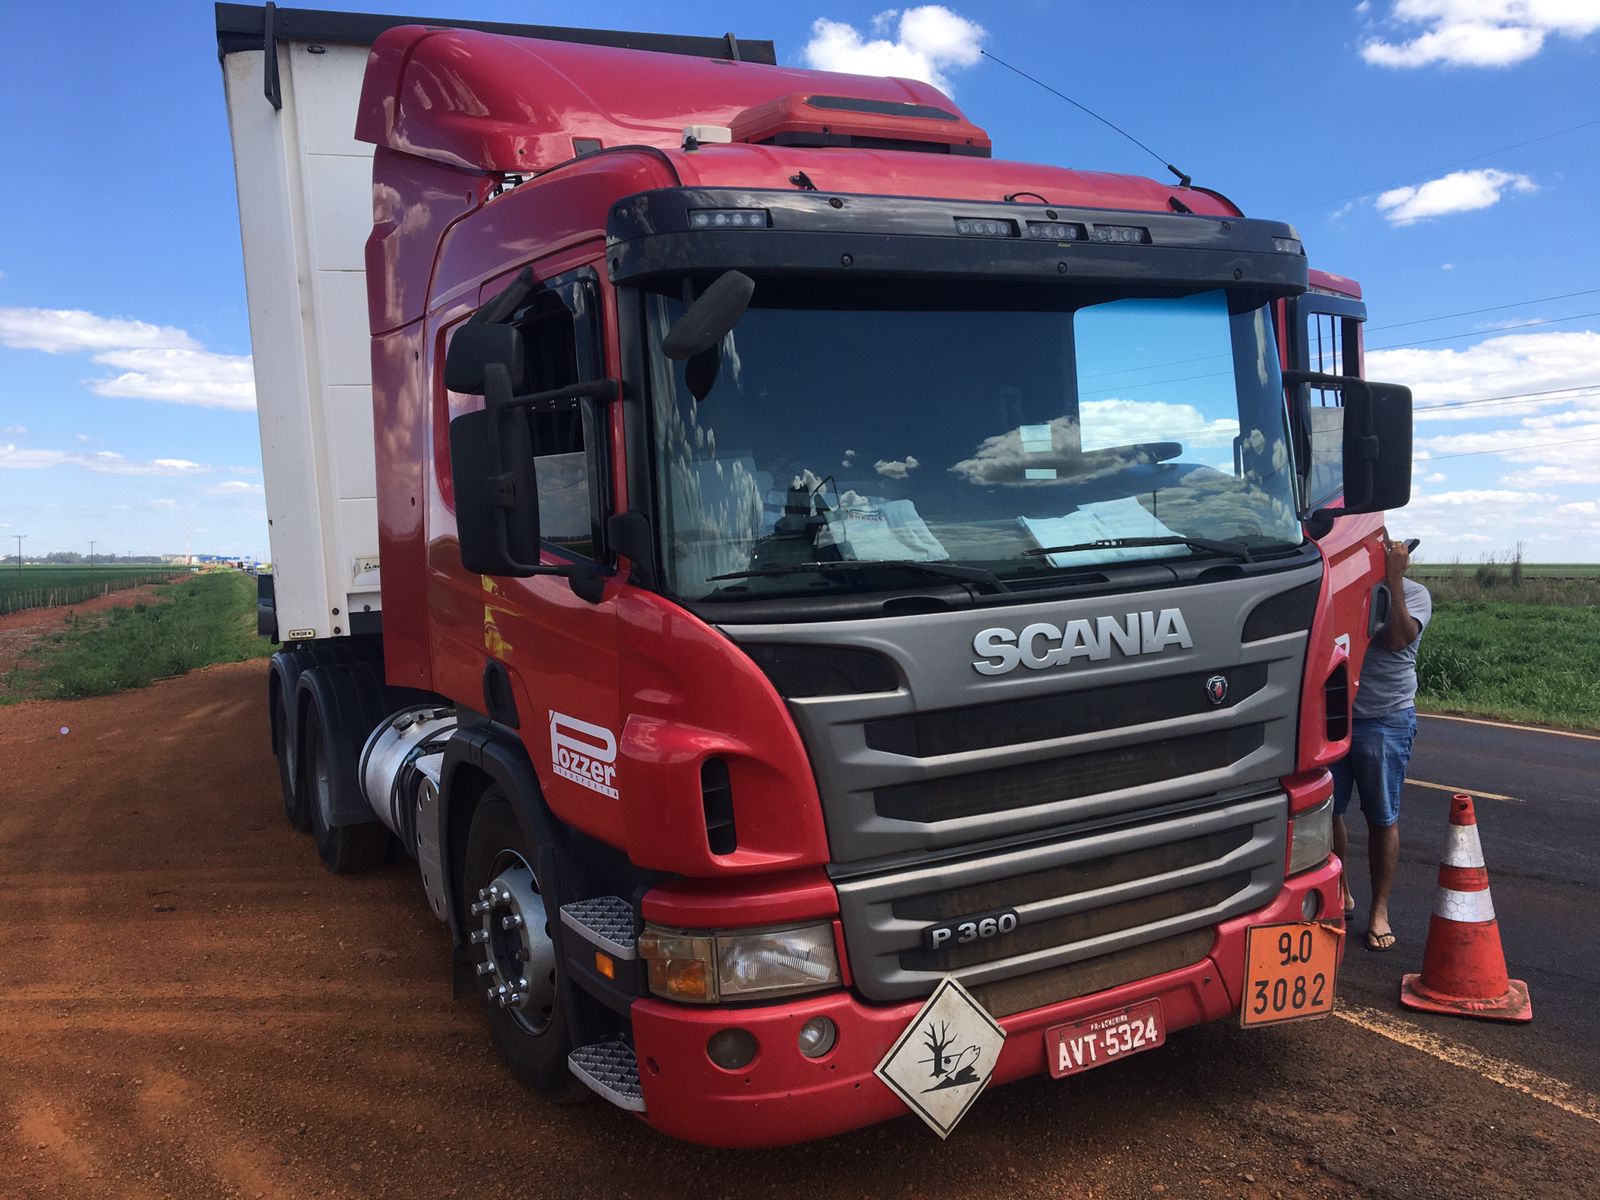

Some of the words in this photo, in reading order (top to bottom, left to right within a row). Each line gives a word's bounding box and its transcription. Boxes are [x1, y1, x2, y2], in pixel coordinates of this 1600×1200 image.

[972, 607, 1194, 676] SCANIA
[548, 709, 617, 786] Pozzer
[932, 928, 952, 950] P
[958, 913, 1017, 943] 360
[1253, 972, 1326, 1015] 3082
